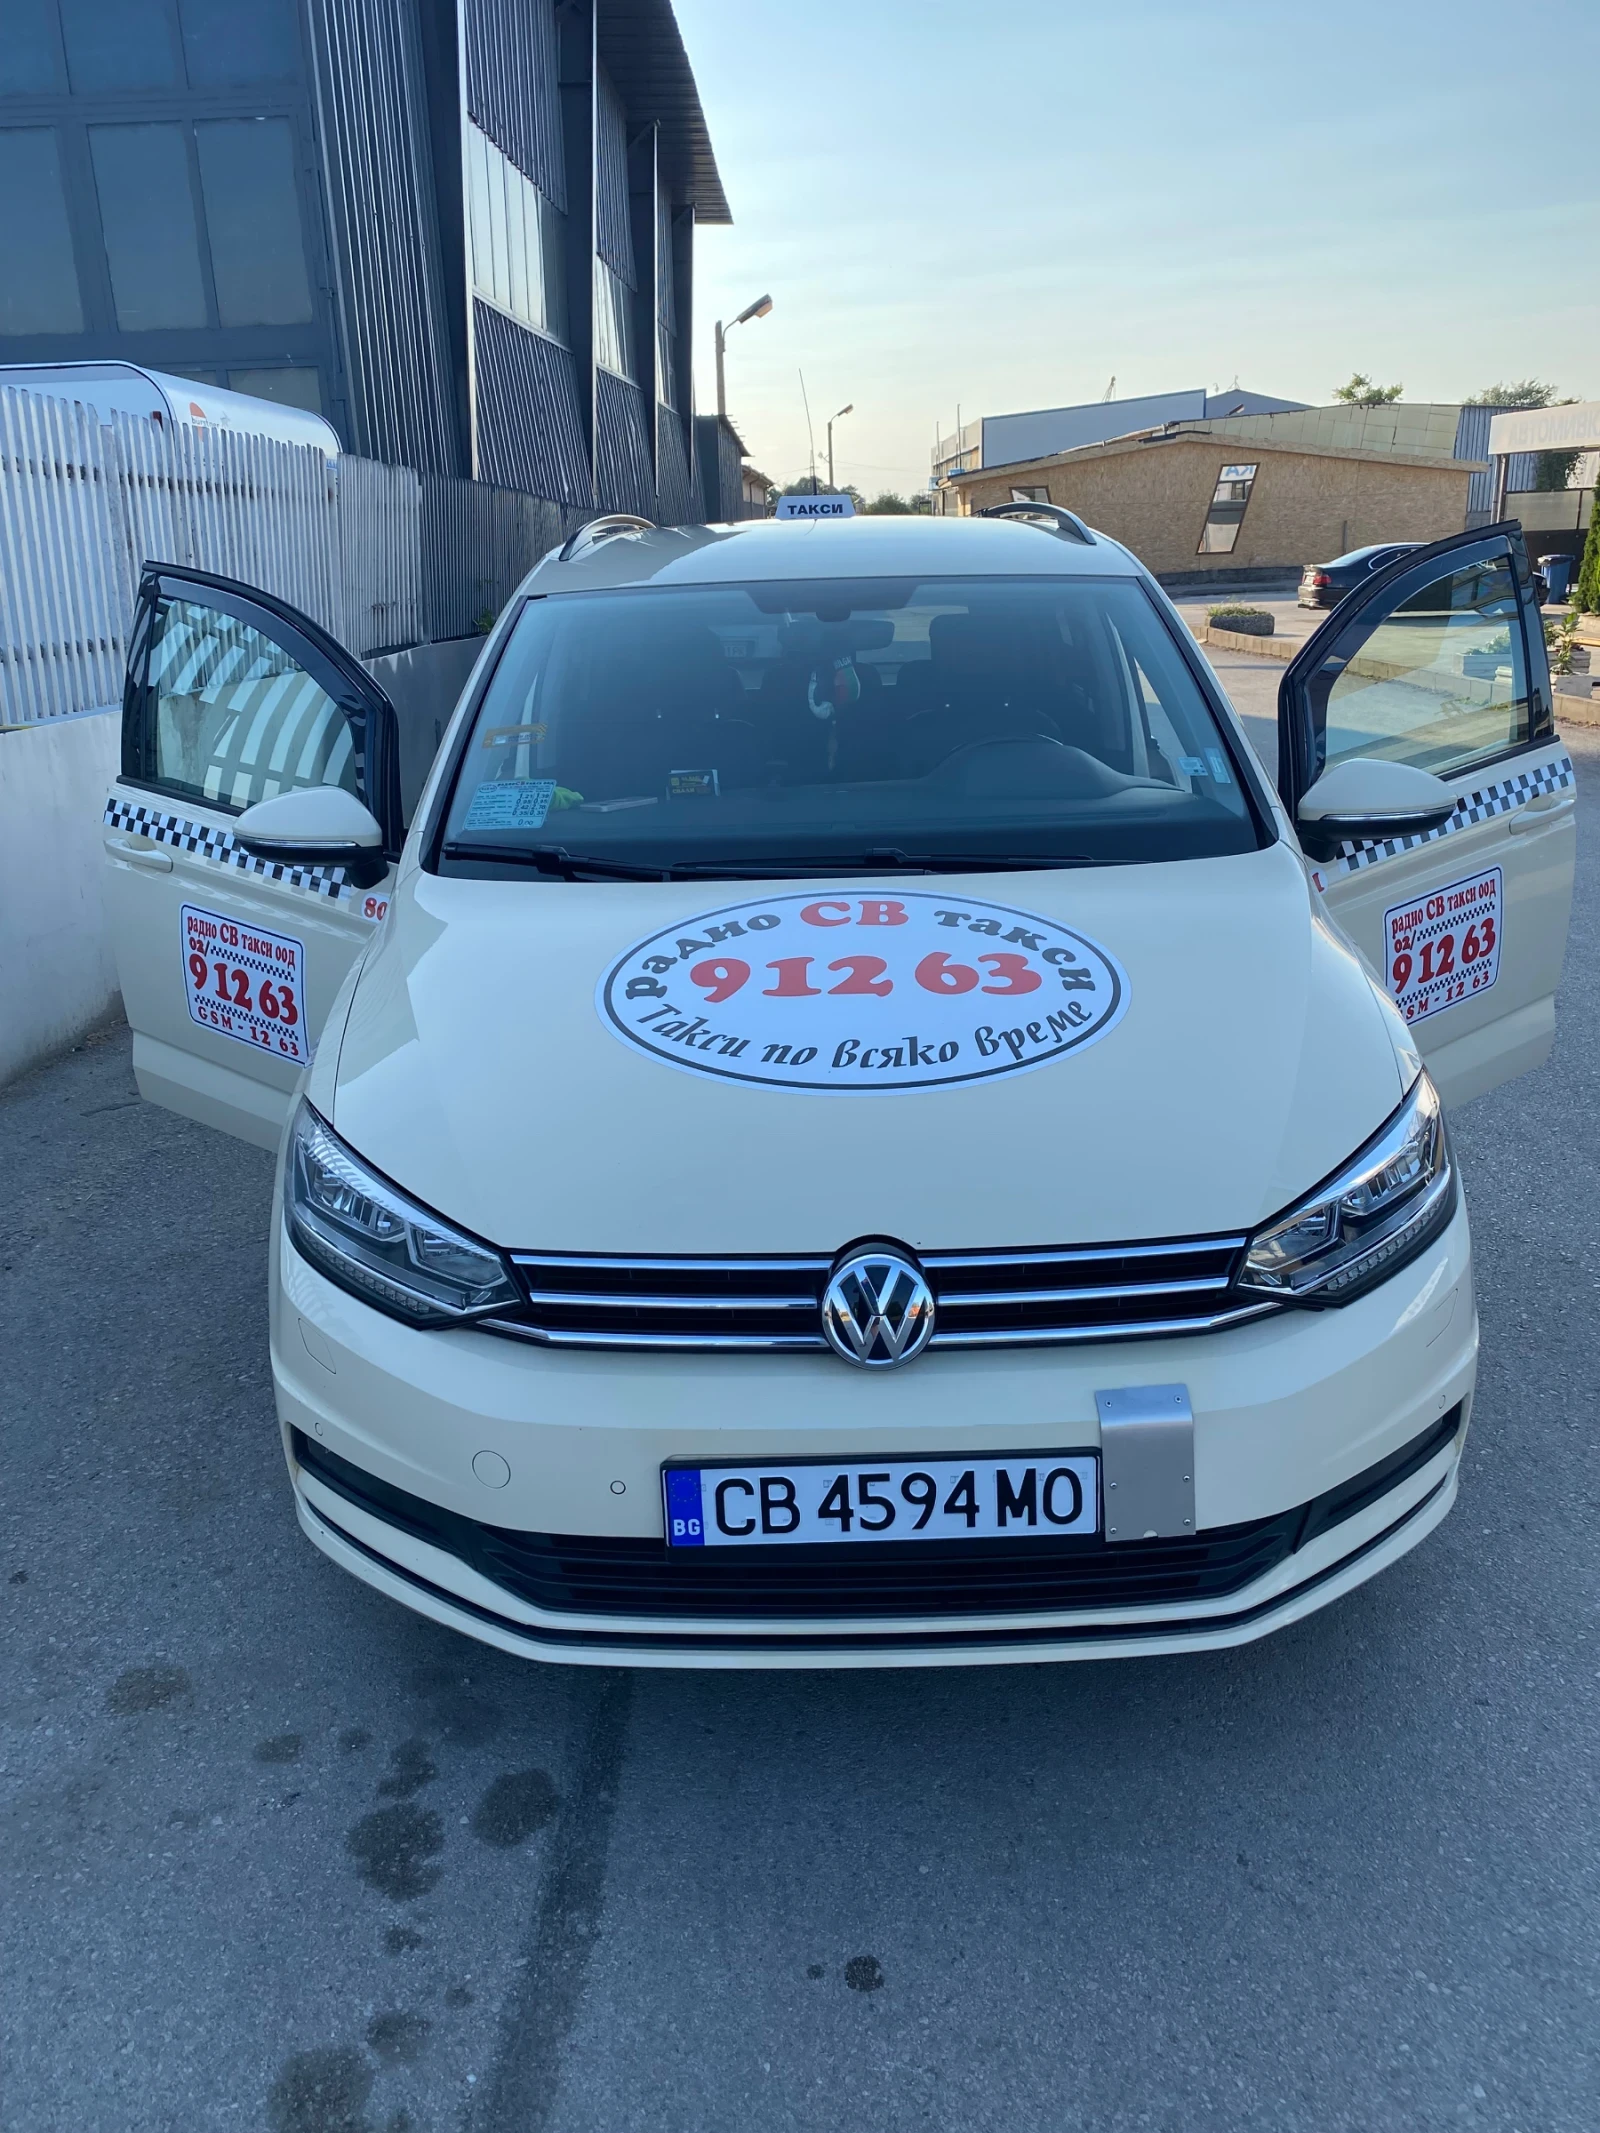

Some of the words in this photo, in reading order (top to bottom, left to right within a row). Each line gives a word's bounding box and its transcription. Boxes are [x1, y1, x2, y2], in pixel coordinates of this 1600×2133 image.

[787, 503, 843, 515] ТАКСИ
[1391, 908, 1423, 939] радио
[1426, 896, 1445, 921] СВ
[1447, 886, 1476, 912] такси
[1478, 878, 1496, 899] оод
[187, 916, 217, 939] радио
[220, 923, 238, 947] СВ
[241, 934, 273, 960] такси
[275, 945, 296, 971] оод
[625, 913, 781, 1000] радио
[800, 900, 909, 927] СВ
[933, 909, 1097, 992] такси
[1400, 996, 1429, 1020] SM
[1446, 982, 1465, 1003] 12
[1472, 970, 1489, 990] 63
[198, 1006, 233, 1030] GSM
[250, 1026, 271, 1046] 12
[279, 1037, 299, 1056] 63
[635, 1002, 752, 1059] Такси
[760, 1043, 818, 1067] по
[831, 1035, 960, 1069] всяко
[973, 1000, 1093, 1061] време
[673, 1519, 701, 1536] BG
[715, 1476, 800, 1537] CB
[818, 1469, 980, 1532] 4594
[996, 1466, 1083, 1527] MO
